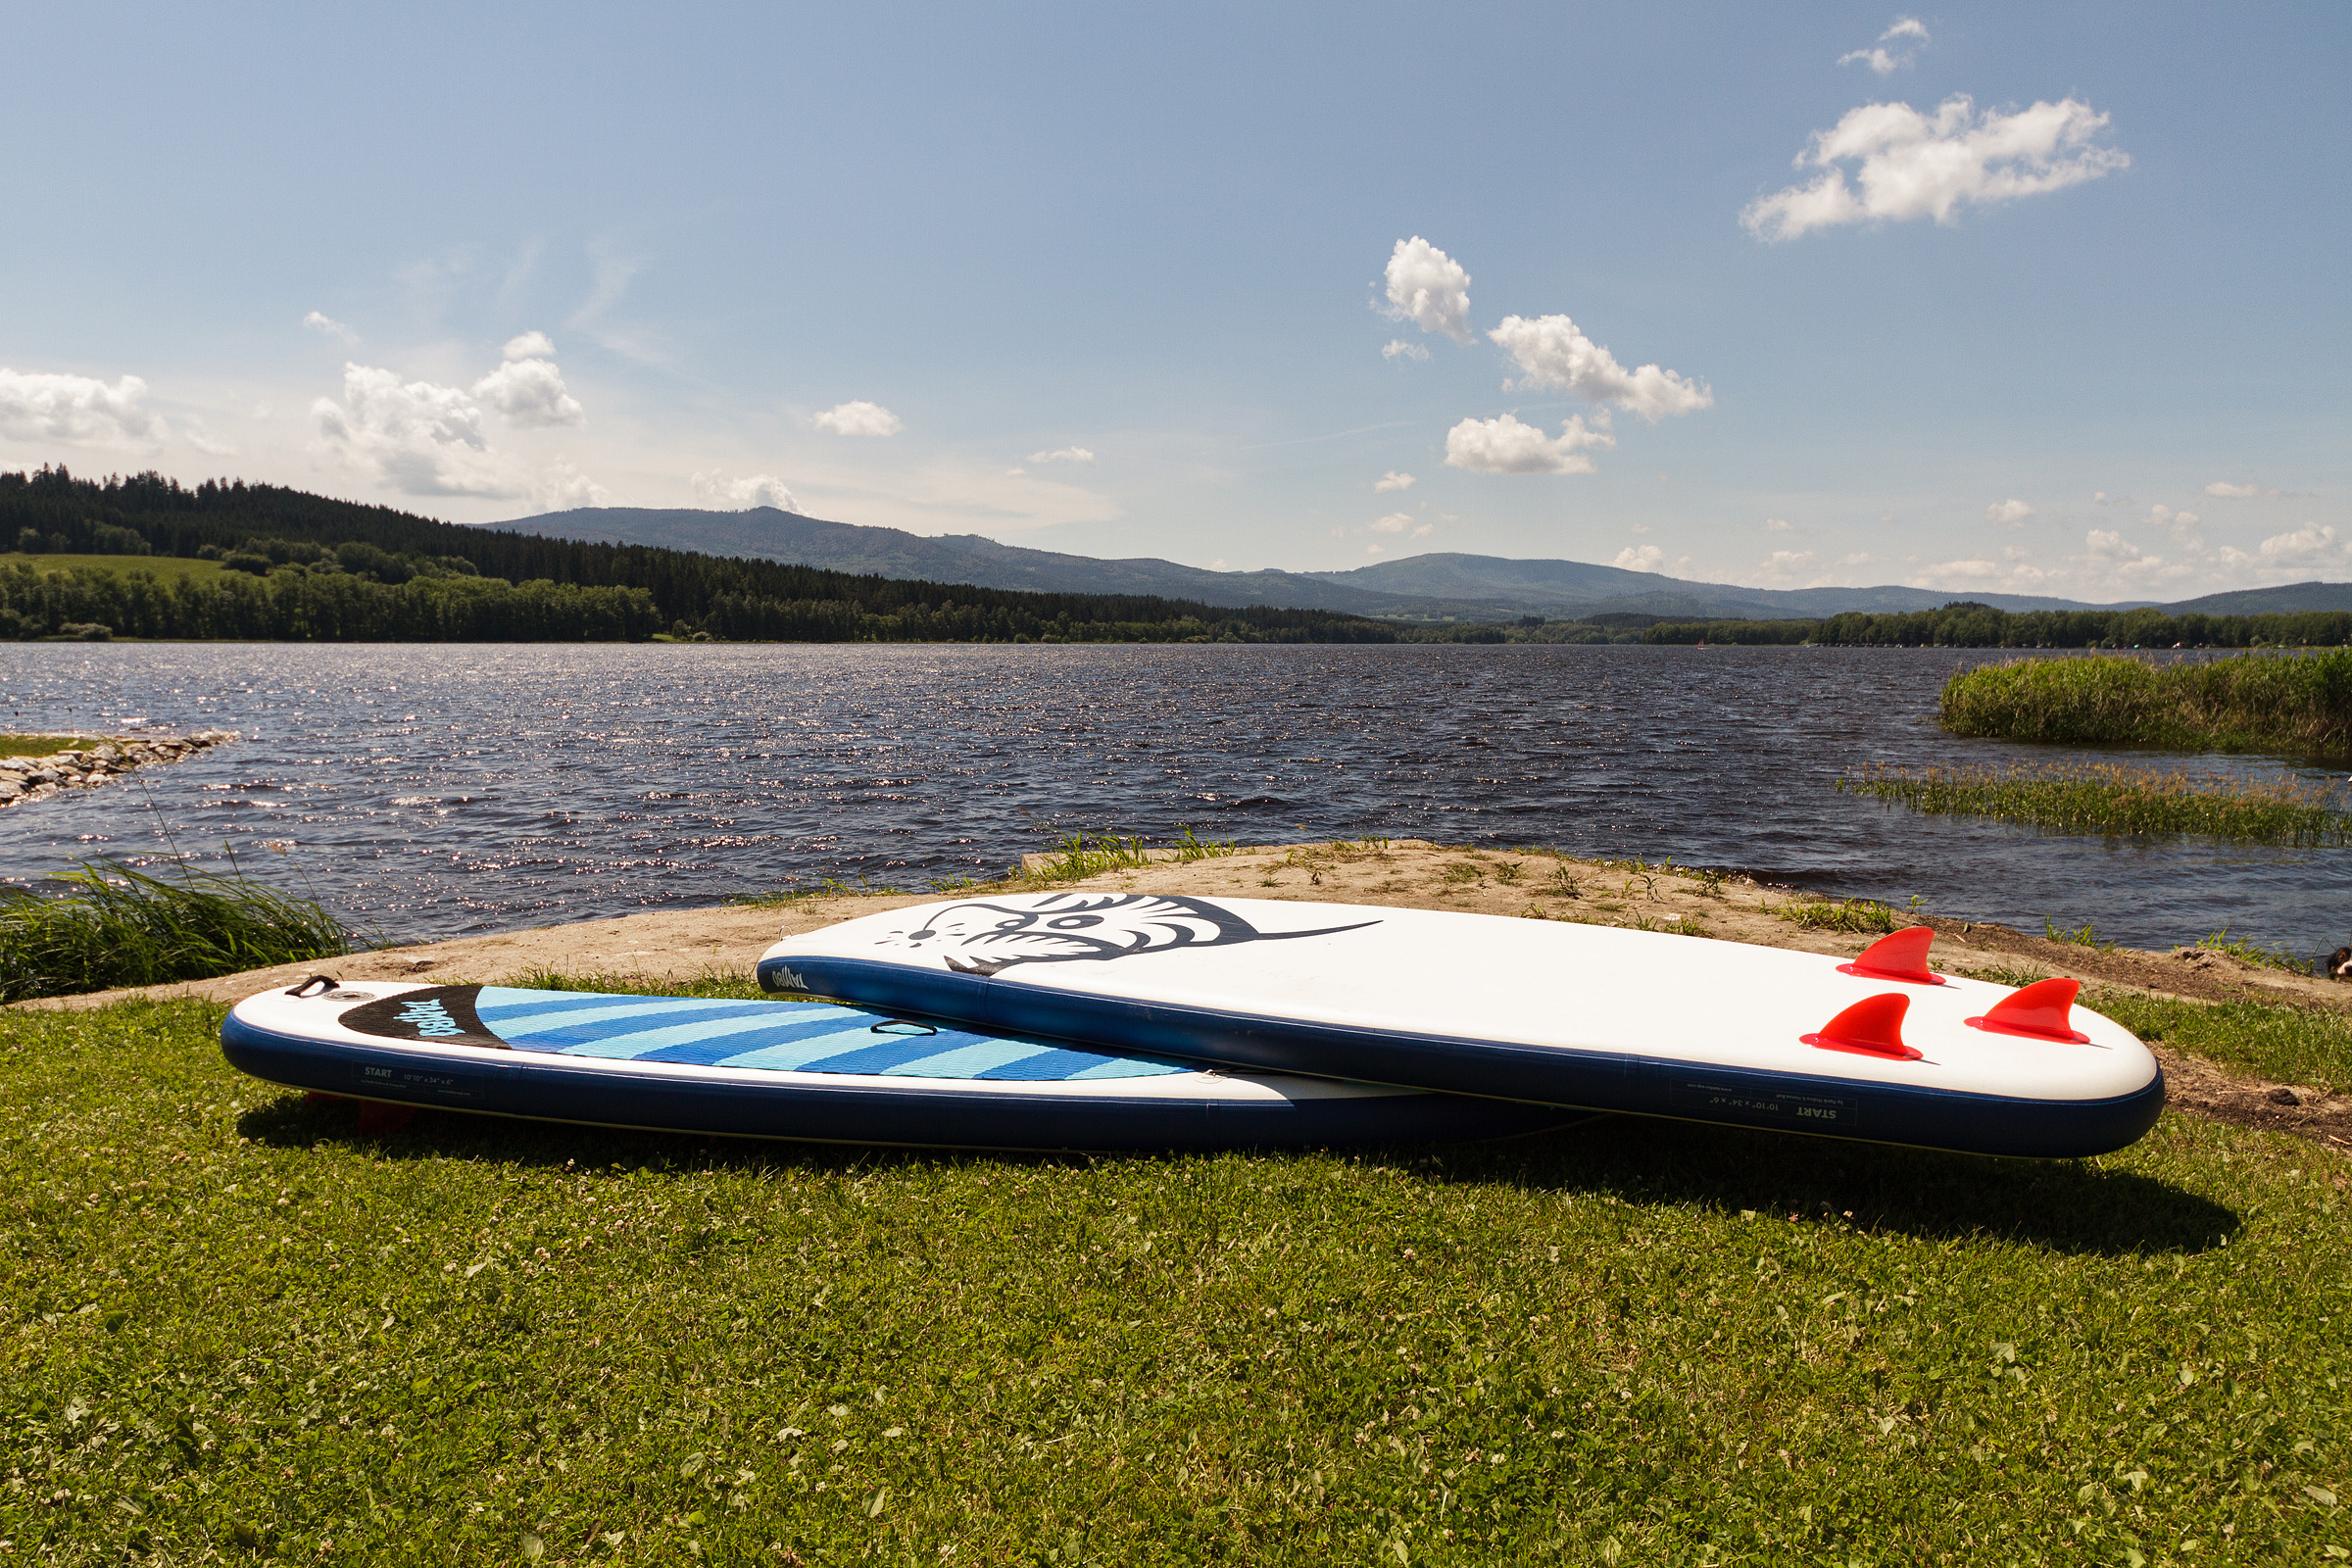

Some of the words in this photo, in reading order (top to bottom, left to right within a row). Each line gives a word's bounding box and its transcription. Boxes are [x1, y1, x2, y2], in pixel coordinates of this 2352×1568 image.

[771, 964, 809, 990] TAMBO
[365, 1066, 393, 1078] START
[1796, 1106, 1838, 1119] START
